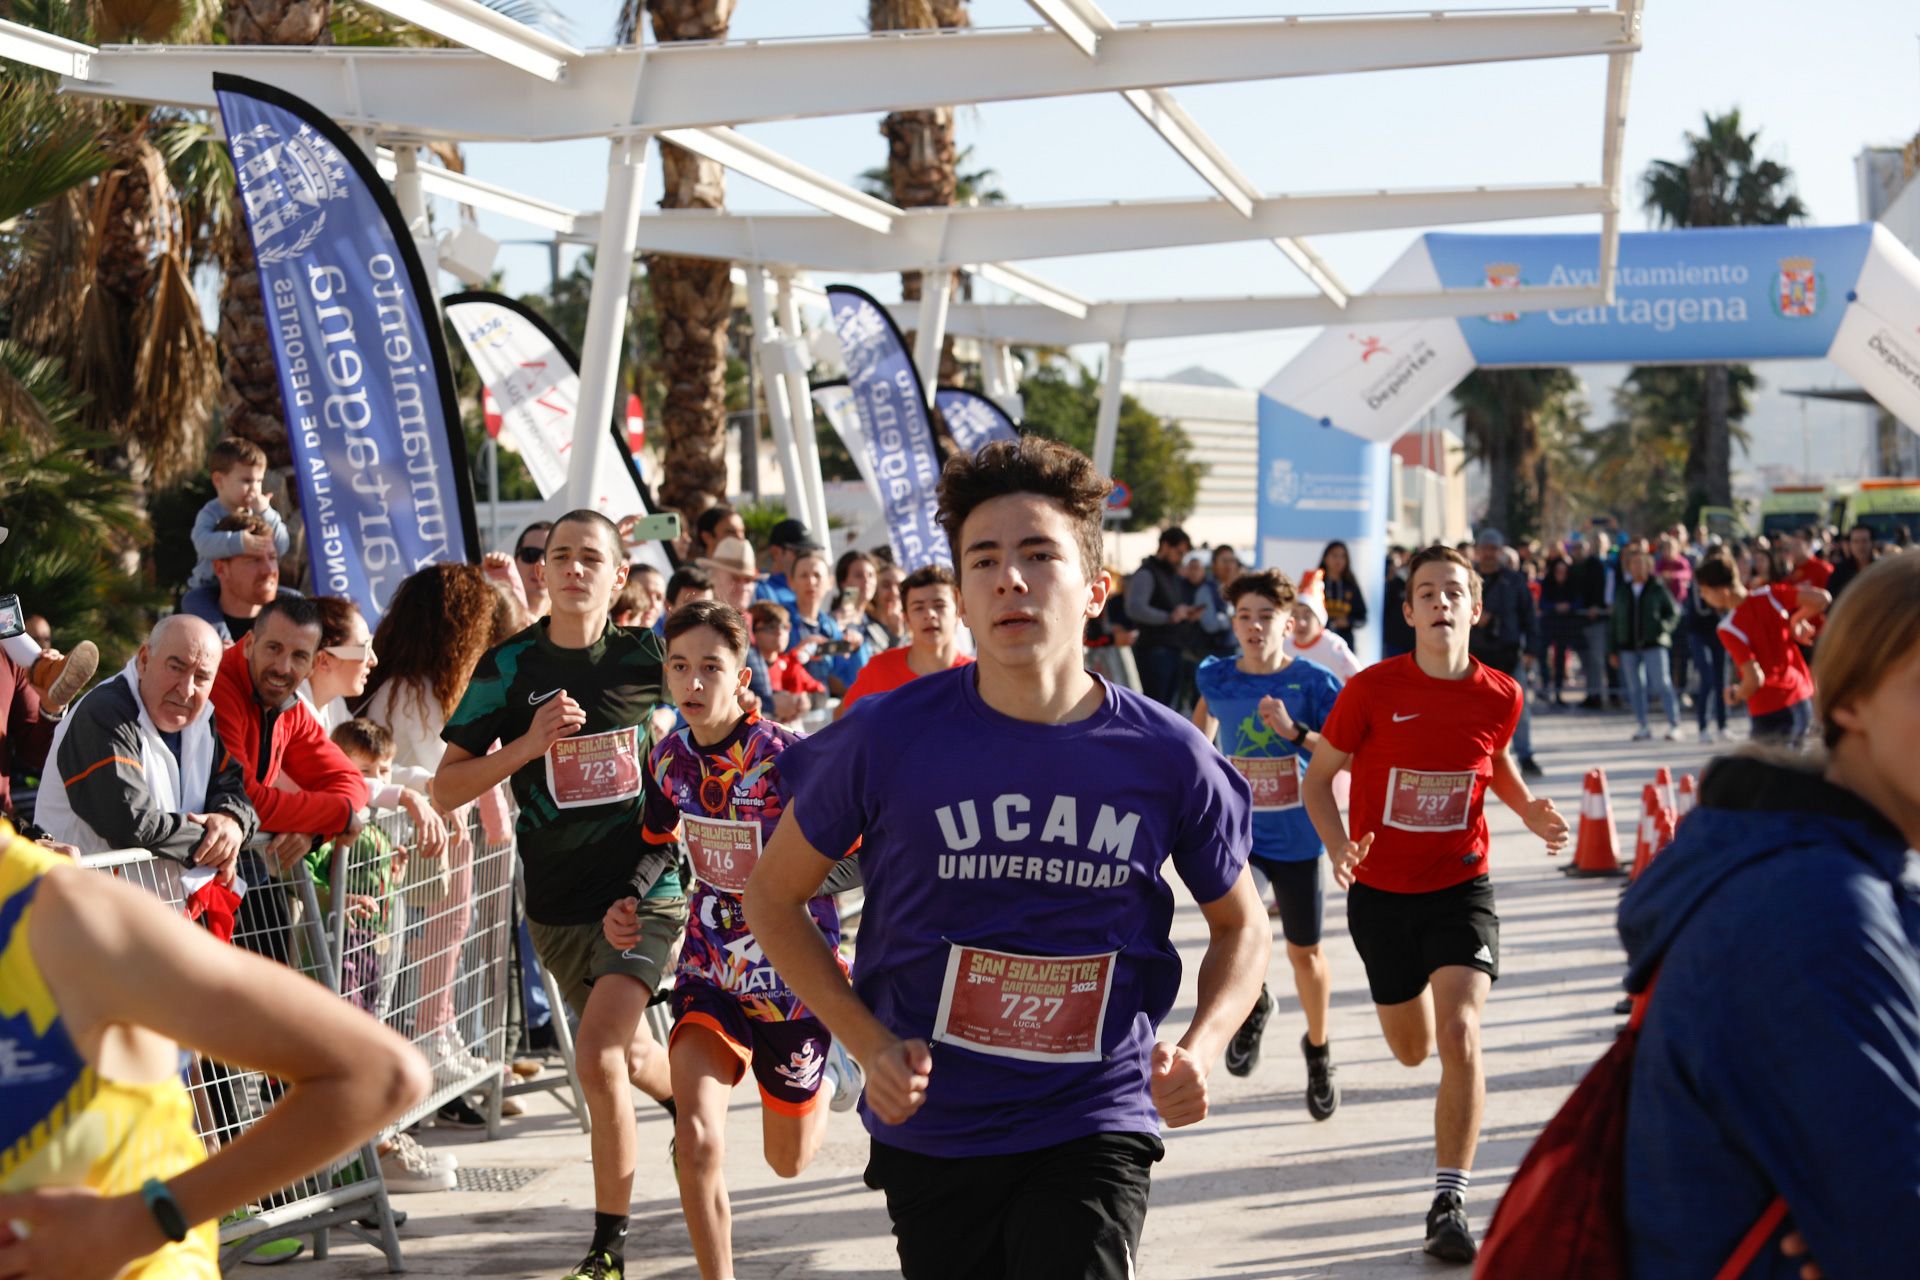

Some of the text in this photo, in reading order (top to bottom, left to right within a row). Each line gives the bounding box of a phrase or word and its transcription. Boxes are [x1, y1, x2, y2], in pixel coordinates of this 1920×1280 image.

[556, 741, 577, 756] SAN
[579, 759, 617, 781] 723
[1250, 778, 1279, 793] 733
[1417, 795, 1450, 811] 737
[935, 793, 1141, 861] UCAM
[703, 848, 734, 870] 716
[938, 854, 1130, 888] UNIVERSIDAD
[970, 952, 1101, 983] SAN SILVESTRE
[1070, 981, 1098, 993] 2022
[1000, 993, 1064, 1022] 727
[1012, 1020, 1042, 1030] LUCAS
